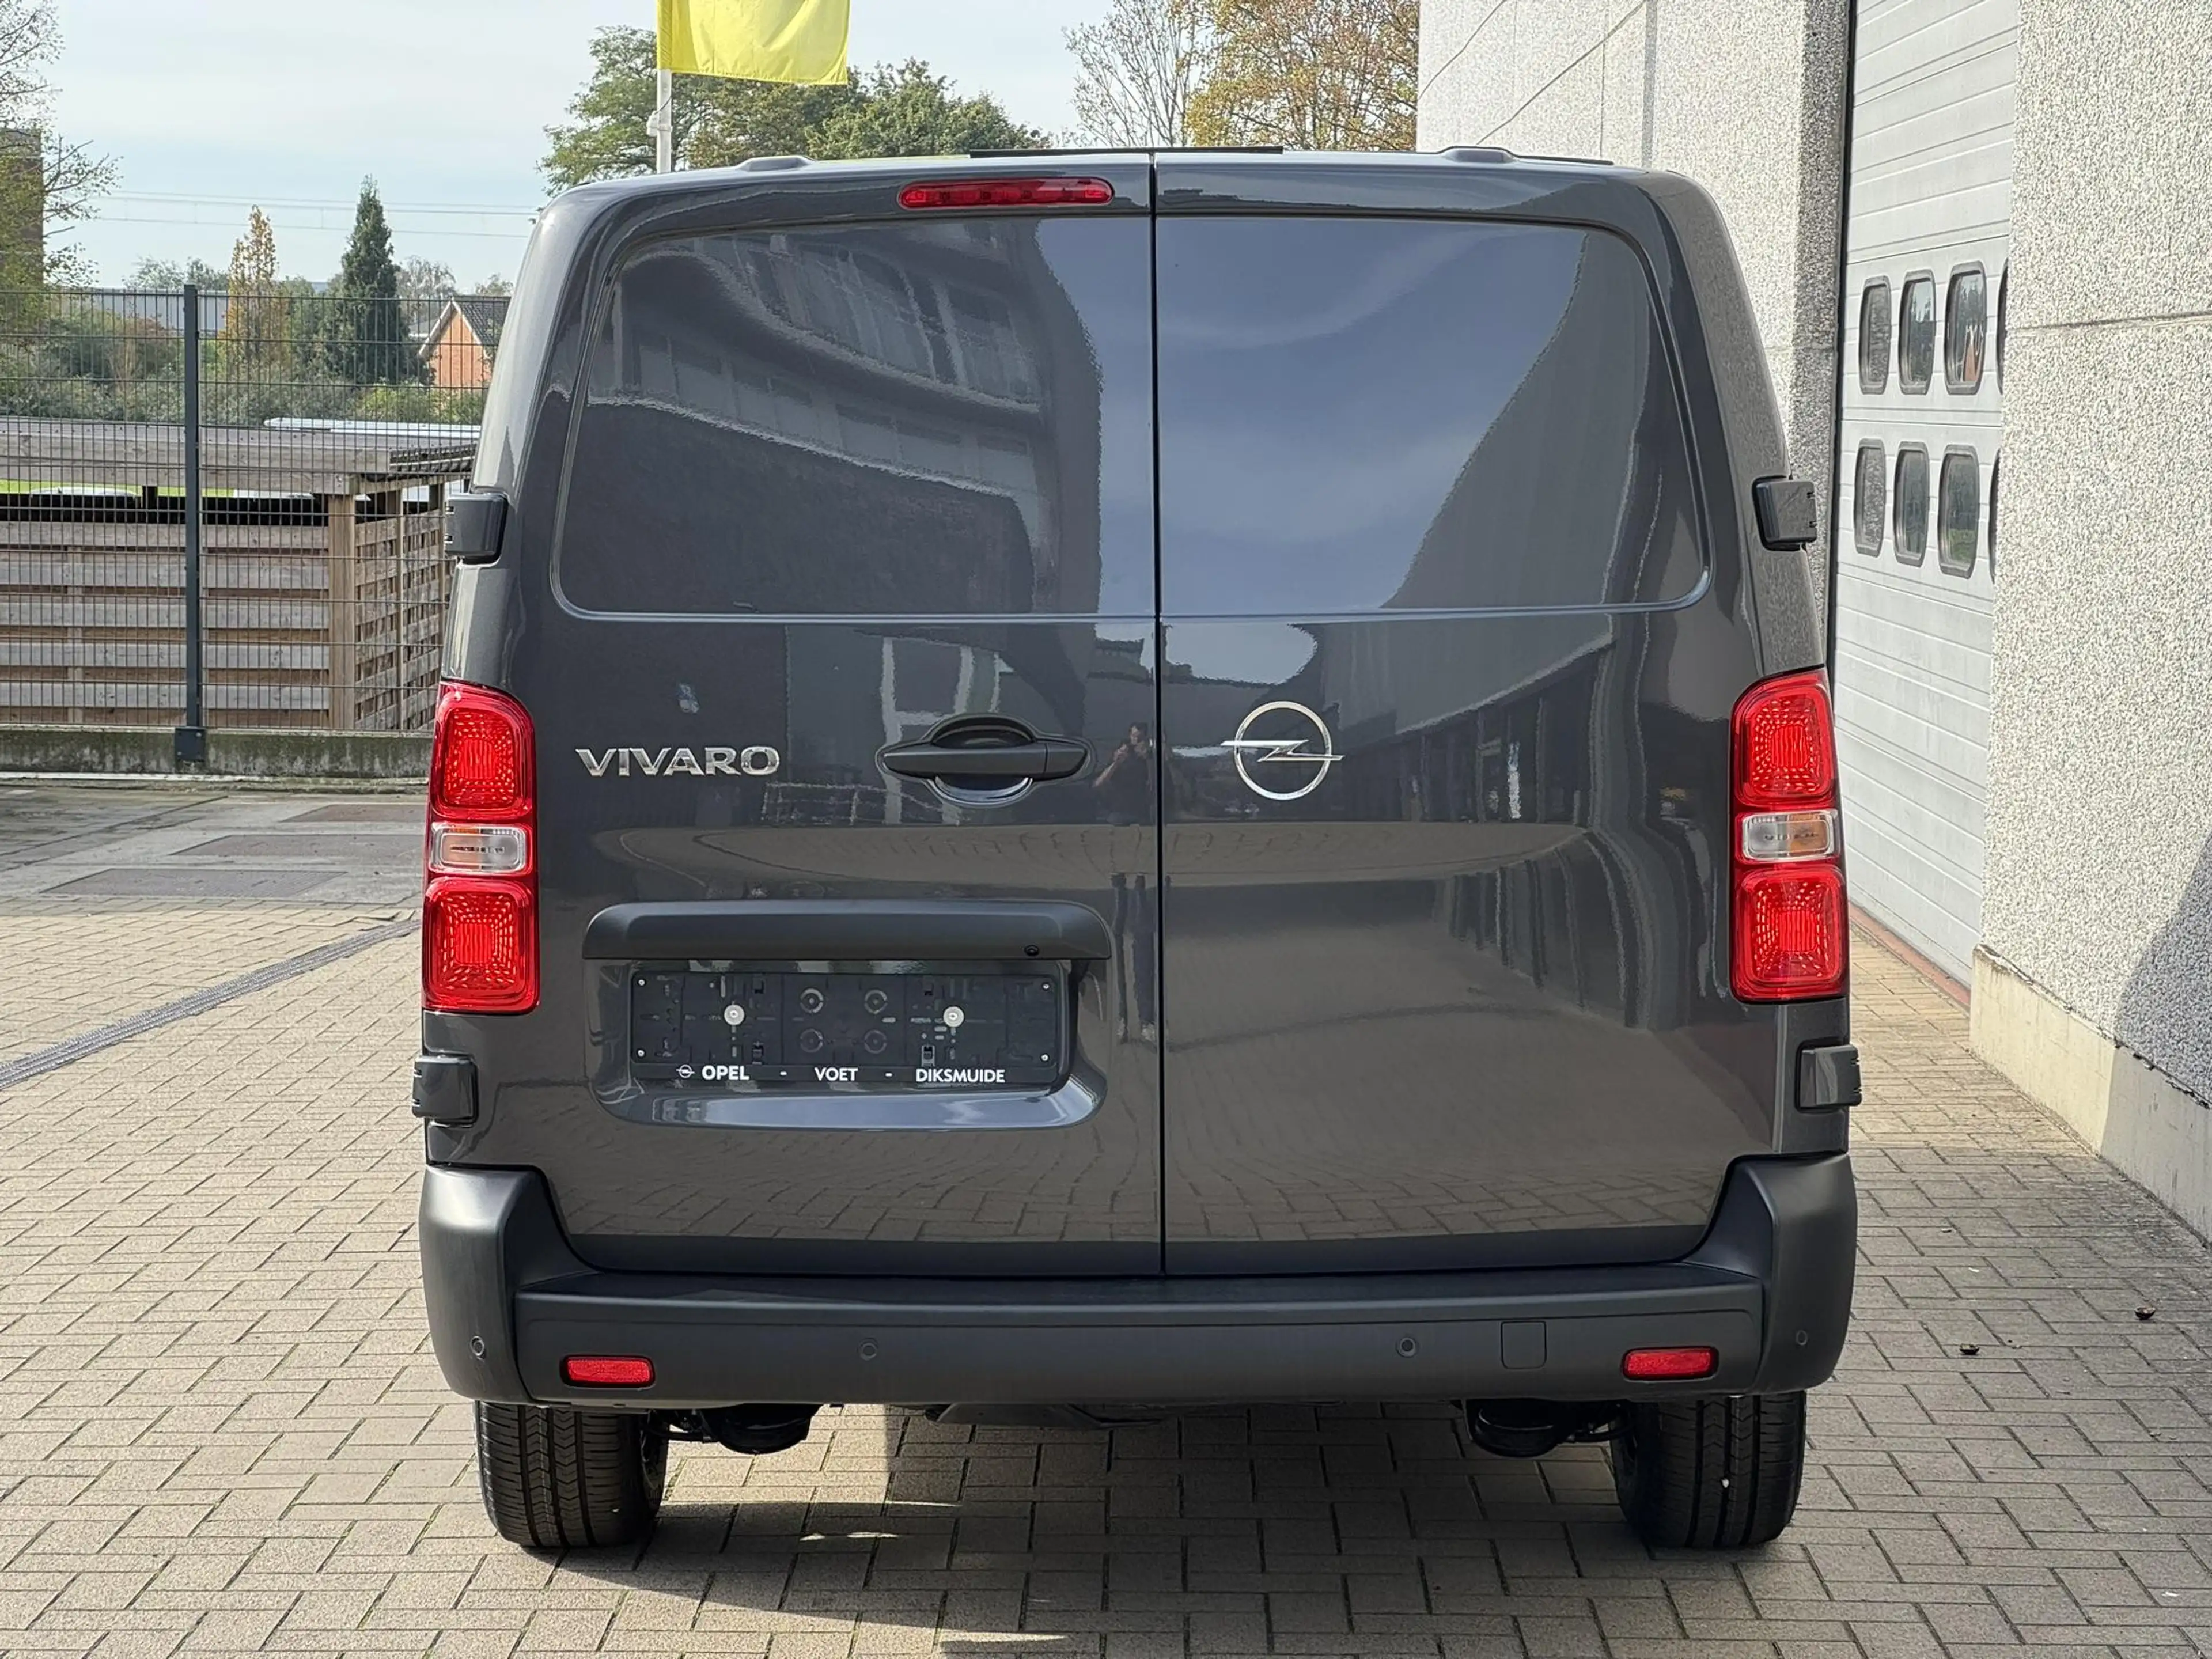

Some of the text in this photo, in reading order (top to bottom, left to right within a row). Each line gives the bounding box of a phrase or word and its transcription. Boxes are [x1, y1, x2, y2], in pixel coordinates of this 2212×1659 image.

[575, 745, 781, 777] VIVARO
[702, 1065, 749, 1080] OPEL
[814, 1066, 858, 1081] VOET
[916, 1067, 1006, 1083] DIKSMUIDE
